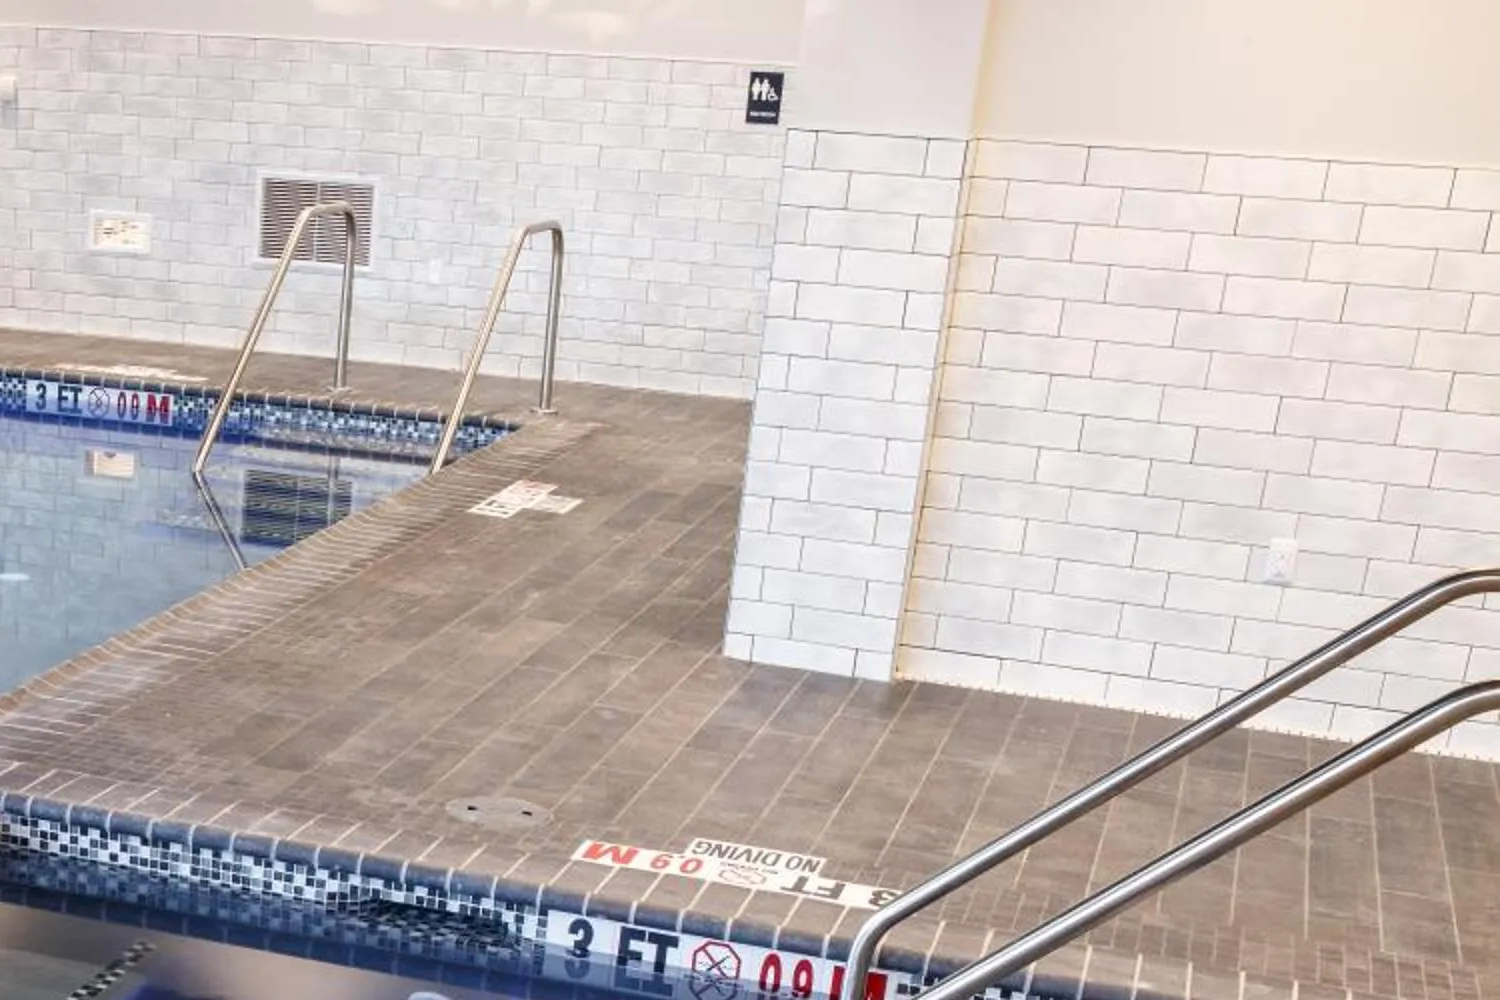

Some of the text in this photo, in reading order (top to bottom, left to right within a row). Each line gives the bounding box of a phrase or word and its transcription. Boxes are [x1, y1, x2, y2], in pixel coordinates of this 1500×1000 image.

[582, 842, 639, 865] M
[692, 840, 781, 867] DIVING
[785, 856, 821, 873] NO
[780, 875, 846, 900] FT
[567, 918, 594, 958] 3
[617, 924, 680, 974] FT
